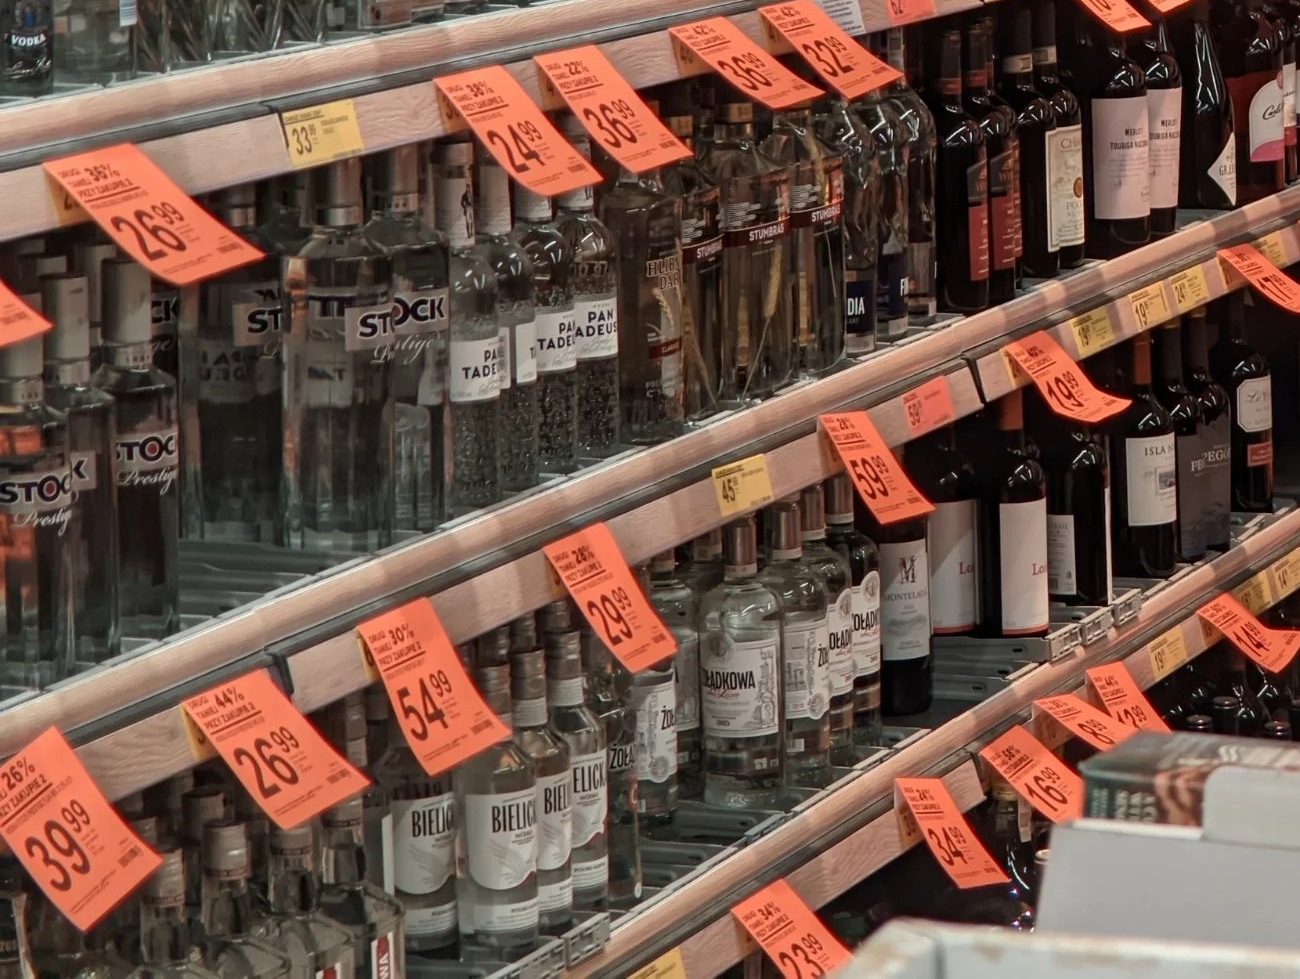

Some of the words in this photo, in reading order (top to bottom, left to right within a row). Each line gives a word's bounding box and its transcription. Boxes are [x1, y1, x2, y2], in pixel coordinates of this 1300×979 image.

[11, 33, 47, 47] VODKA
[811, 203, 841, 223] STUMBRAS
[749, 224, 785, 243] STUMBRAS
[587, 309, 614, 324] PAN
[215, 687, 245, 708] 44%
[4, 756, 35, 789] 26%
